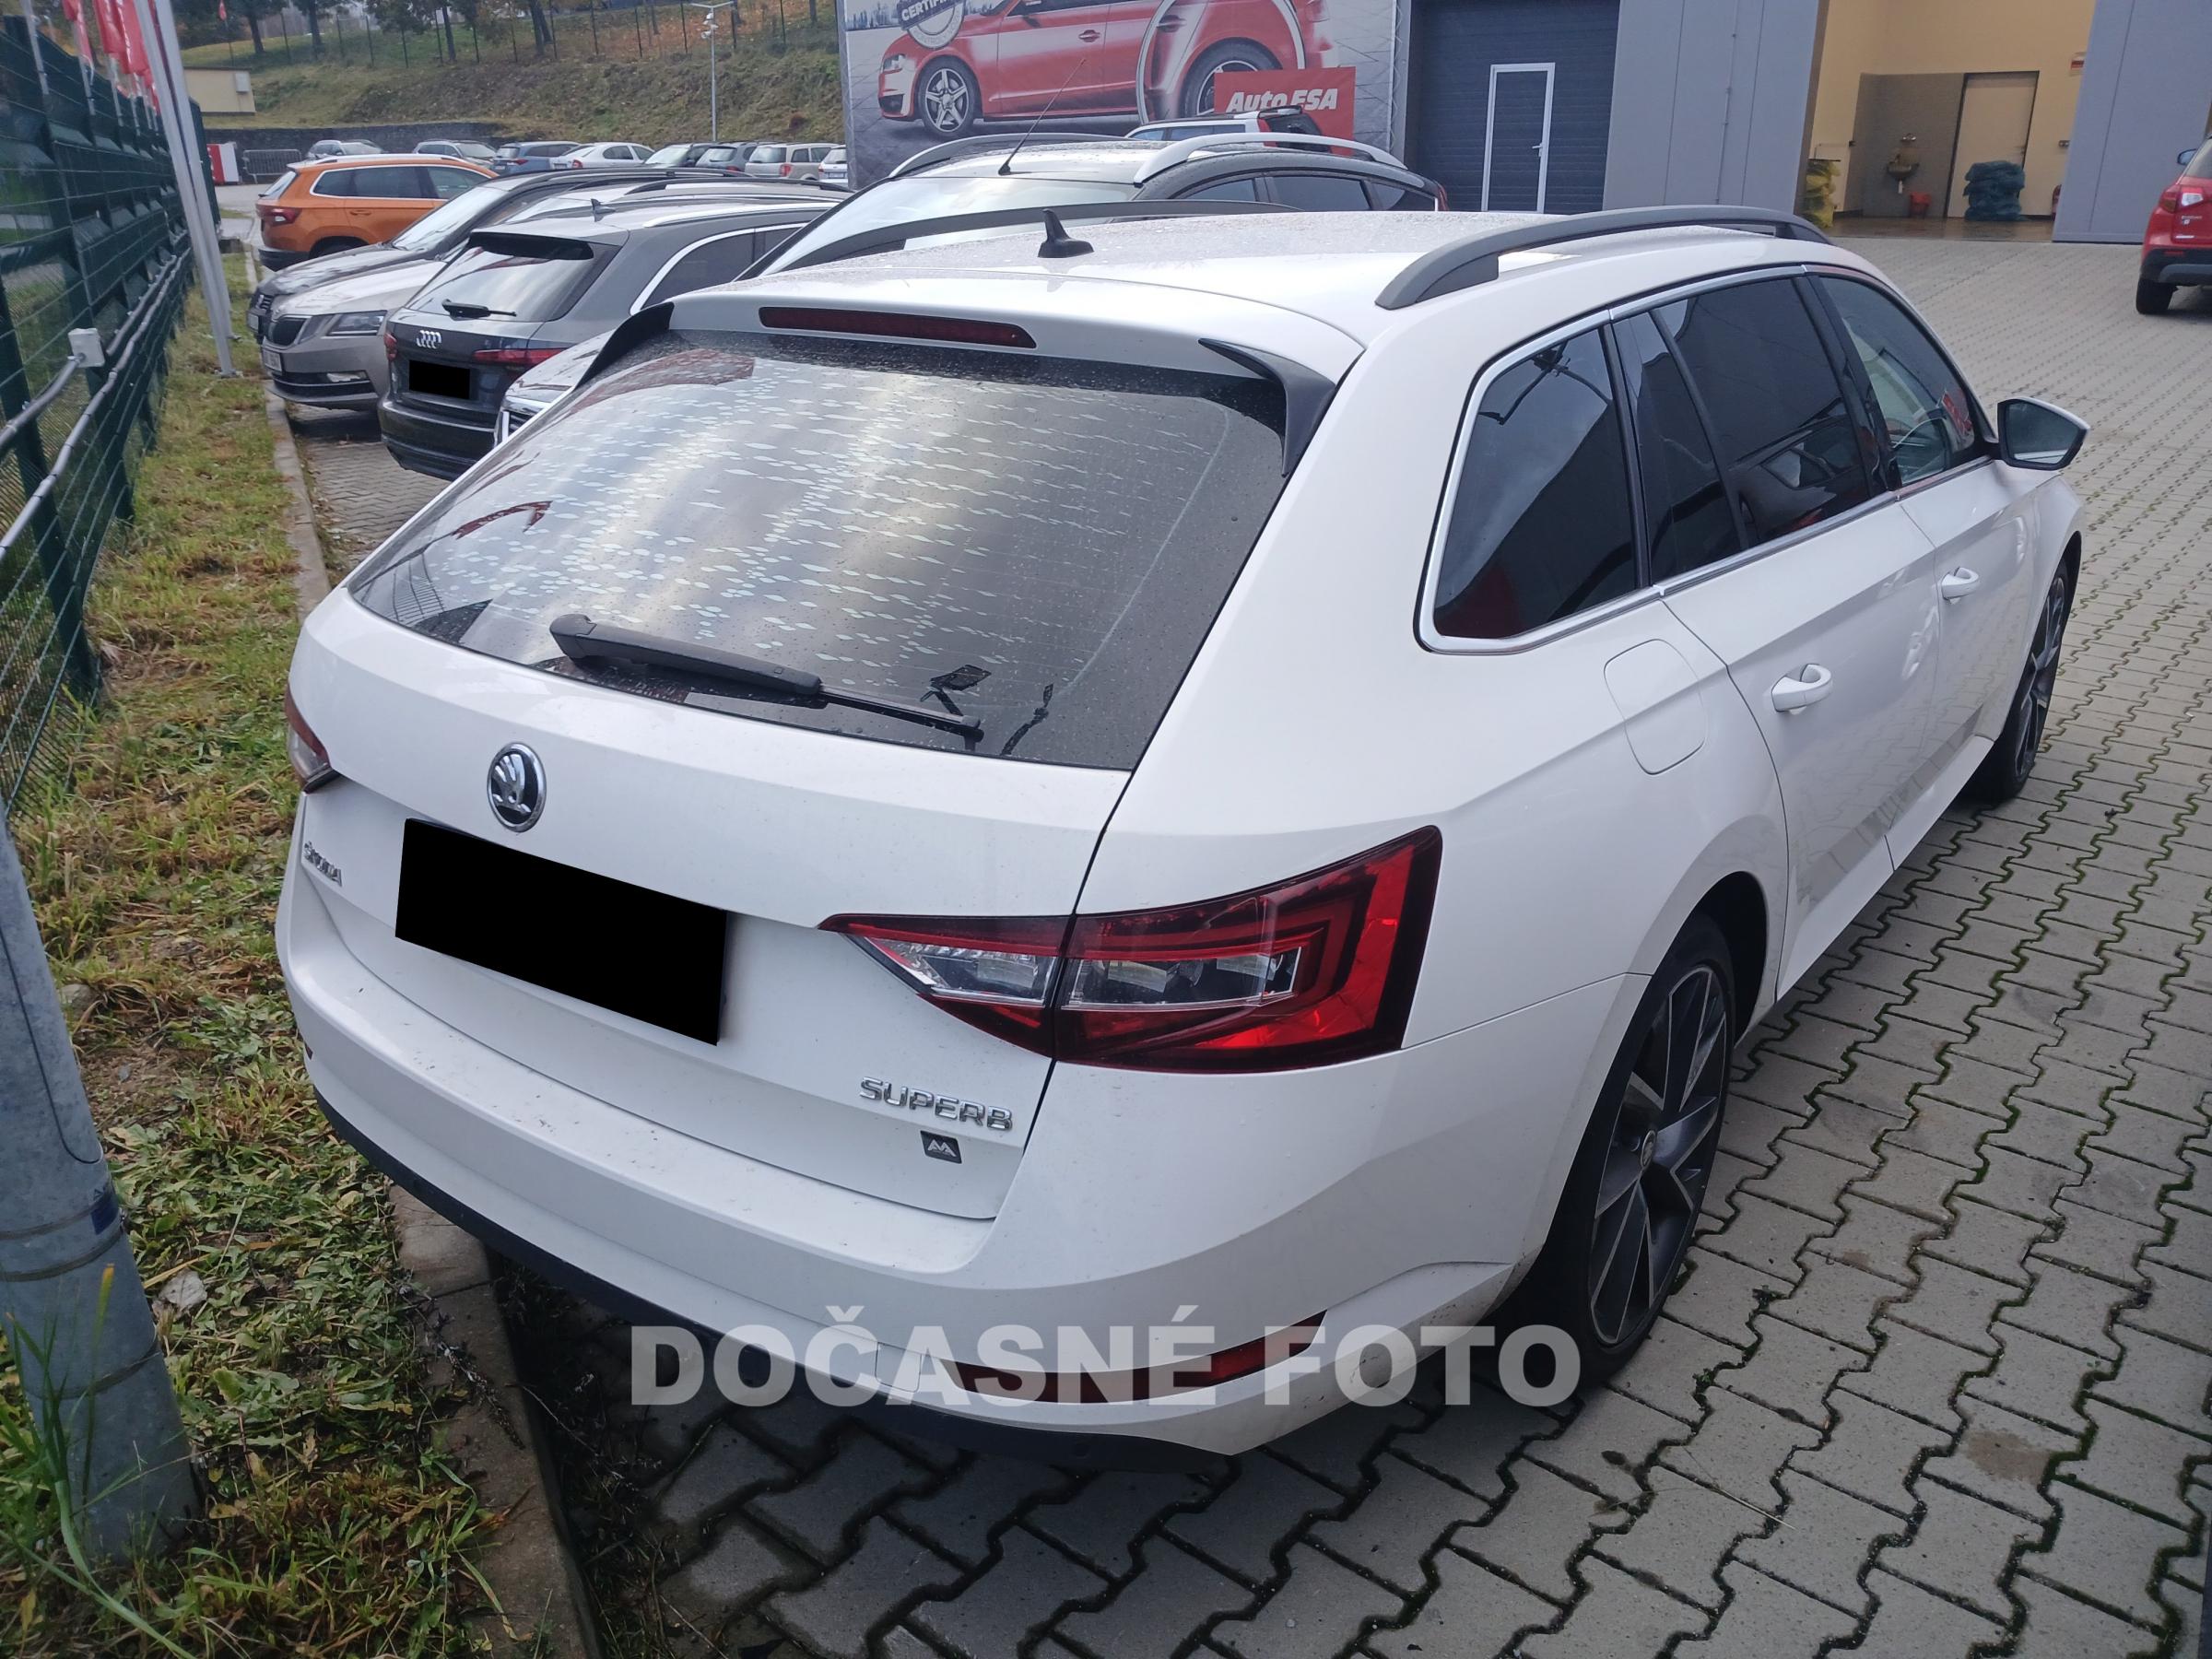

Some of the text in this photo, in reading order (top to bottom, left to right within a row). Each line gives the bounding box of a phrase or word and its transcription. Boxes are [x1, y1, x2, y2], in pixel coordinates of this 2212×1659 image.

[1226, 88, 1338, 112] Auto ESA
[859, 1076, 1013, 1131] SUPERB
